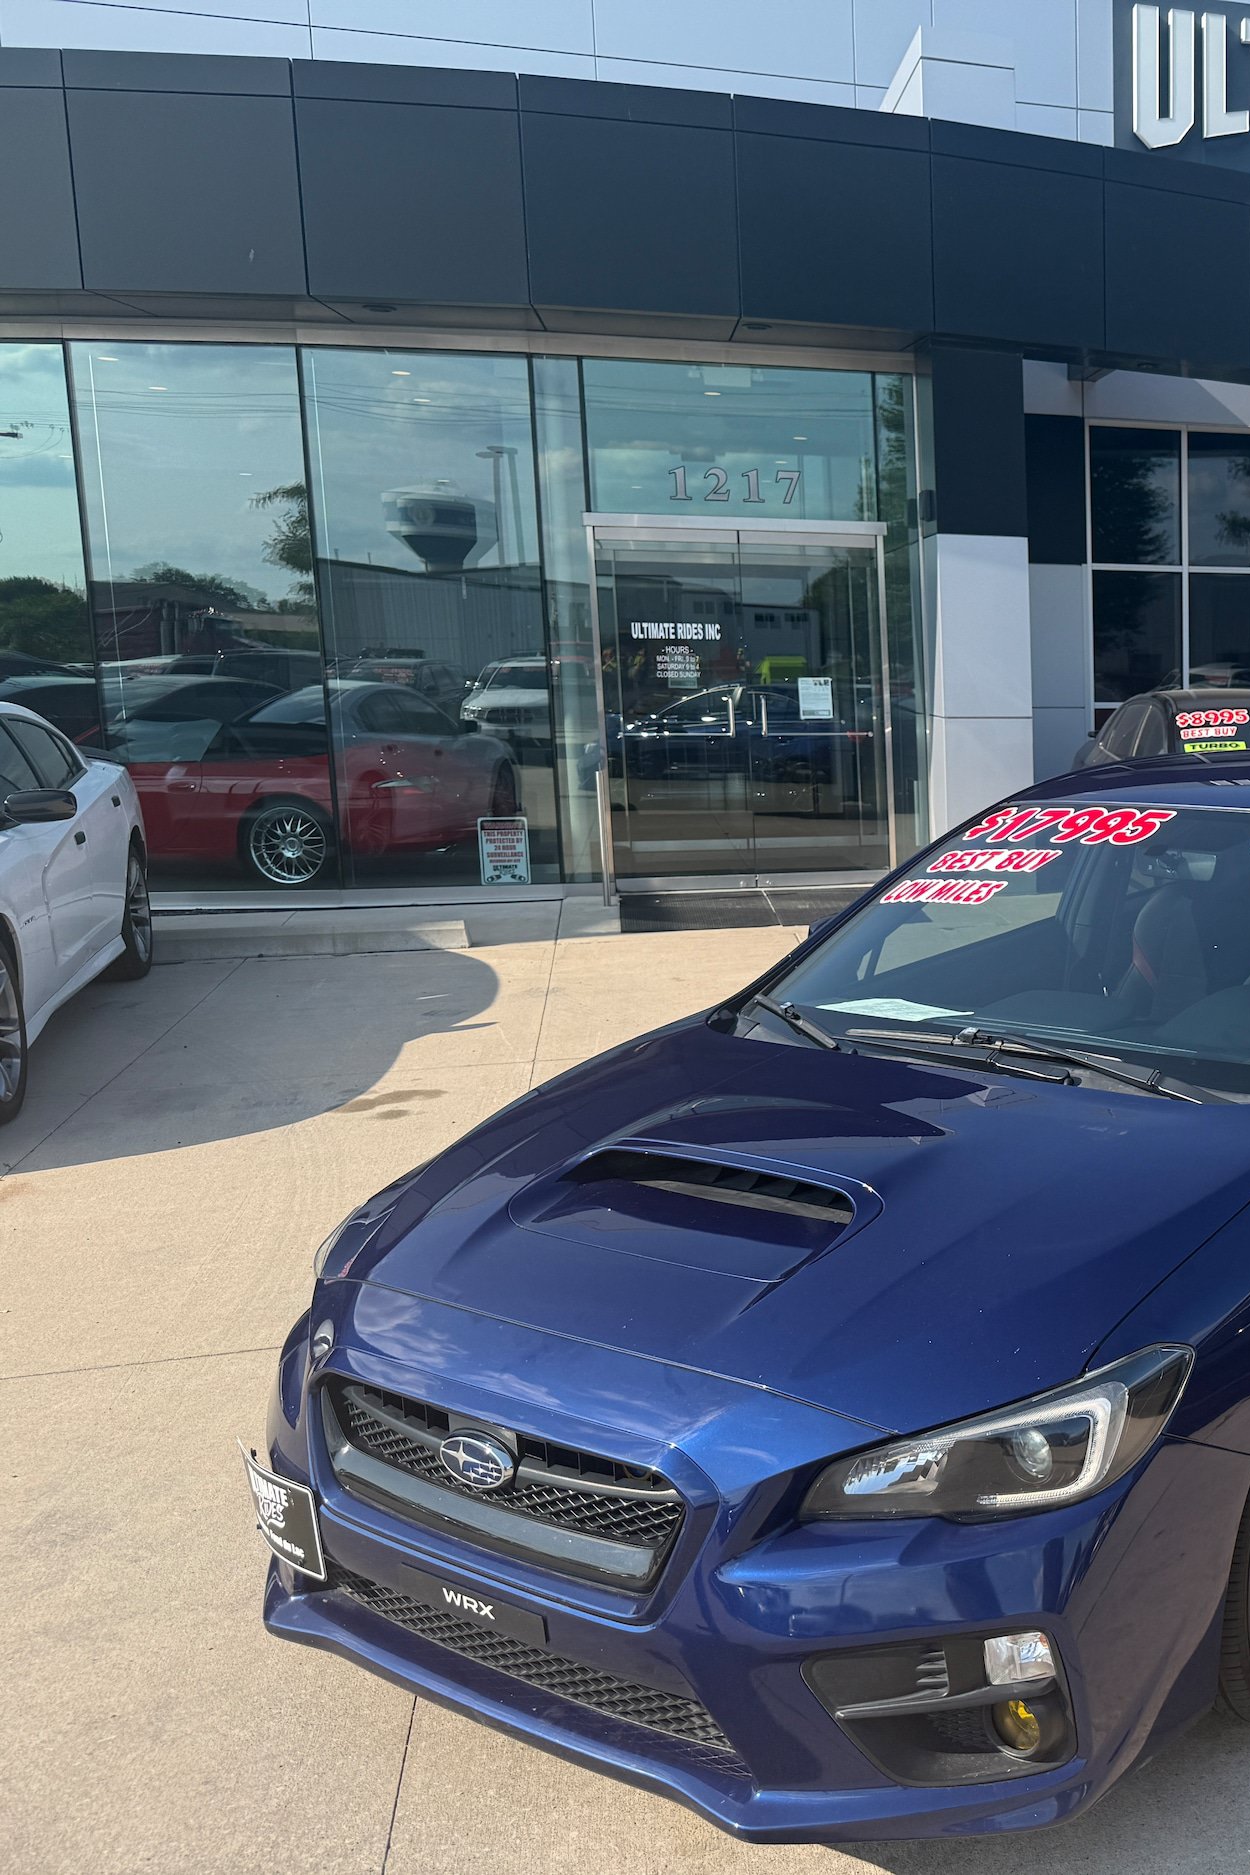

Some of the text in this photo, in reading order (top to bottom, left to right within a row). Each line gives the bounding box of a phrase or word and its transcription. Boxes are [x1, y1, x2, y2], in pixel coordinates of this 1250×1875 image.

[668, 466, 801, 504] 1217
[631, 622, 721, 641] ULTIMATE RIDES INC
[665, 645, 690, 654] HOURS
[1176, 708, 1250, 727] $8995
[1182, 726, 1237, 739] BEST BUY
[1189, 742, 1241, 750] TURBO
[964, 808, 1177, 845] $17995
[929, 850, 1061, 872] BEST BUY
[884, 880, 1006, 903] LOW MILES
[441, 1586, 496, 1620] WRX
